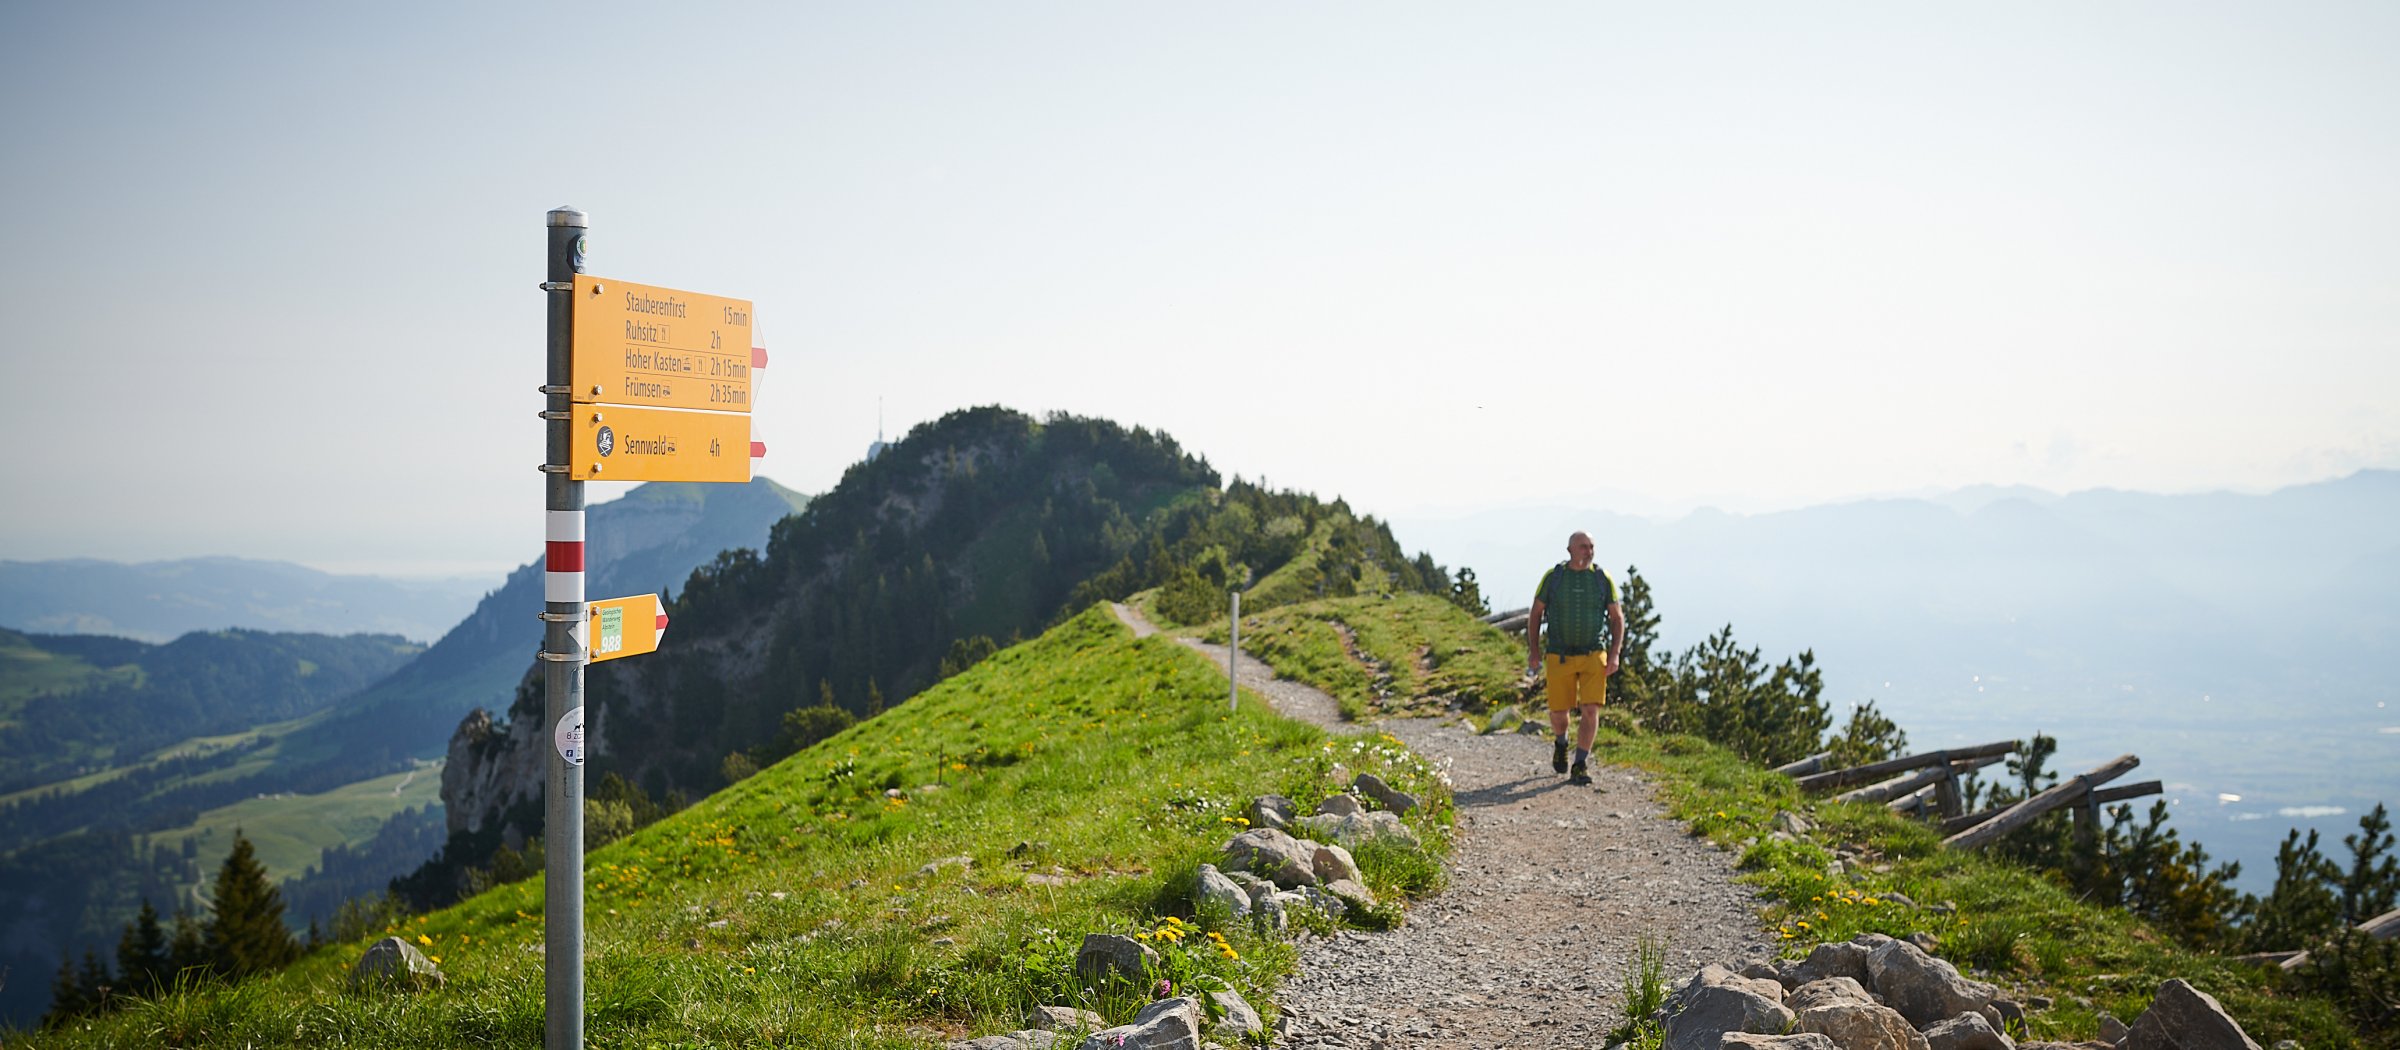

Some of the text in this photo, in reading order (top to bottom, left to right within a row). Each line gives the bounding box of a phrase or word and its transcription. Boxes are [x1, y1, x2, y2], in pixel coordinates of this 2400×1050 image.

[625, 291, 687, 319] Stauberenfirst
[625, 320, 722, 350] Ruhsitz 2h
[625, 352, 652, 370] Hoher
[653, 352, 682, 373] Kasten
[710, 357, 721, 376] 2h
[625, 376, 662, 398] Frümsen
[710, 383, 721, 402] 2h
[624, 434, 721, 457] Sennwald 4h
[601, 635, 622, 653] 988
